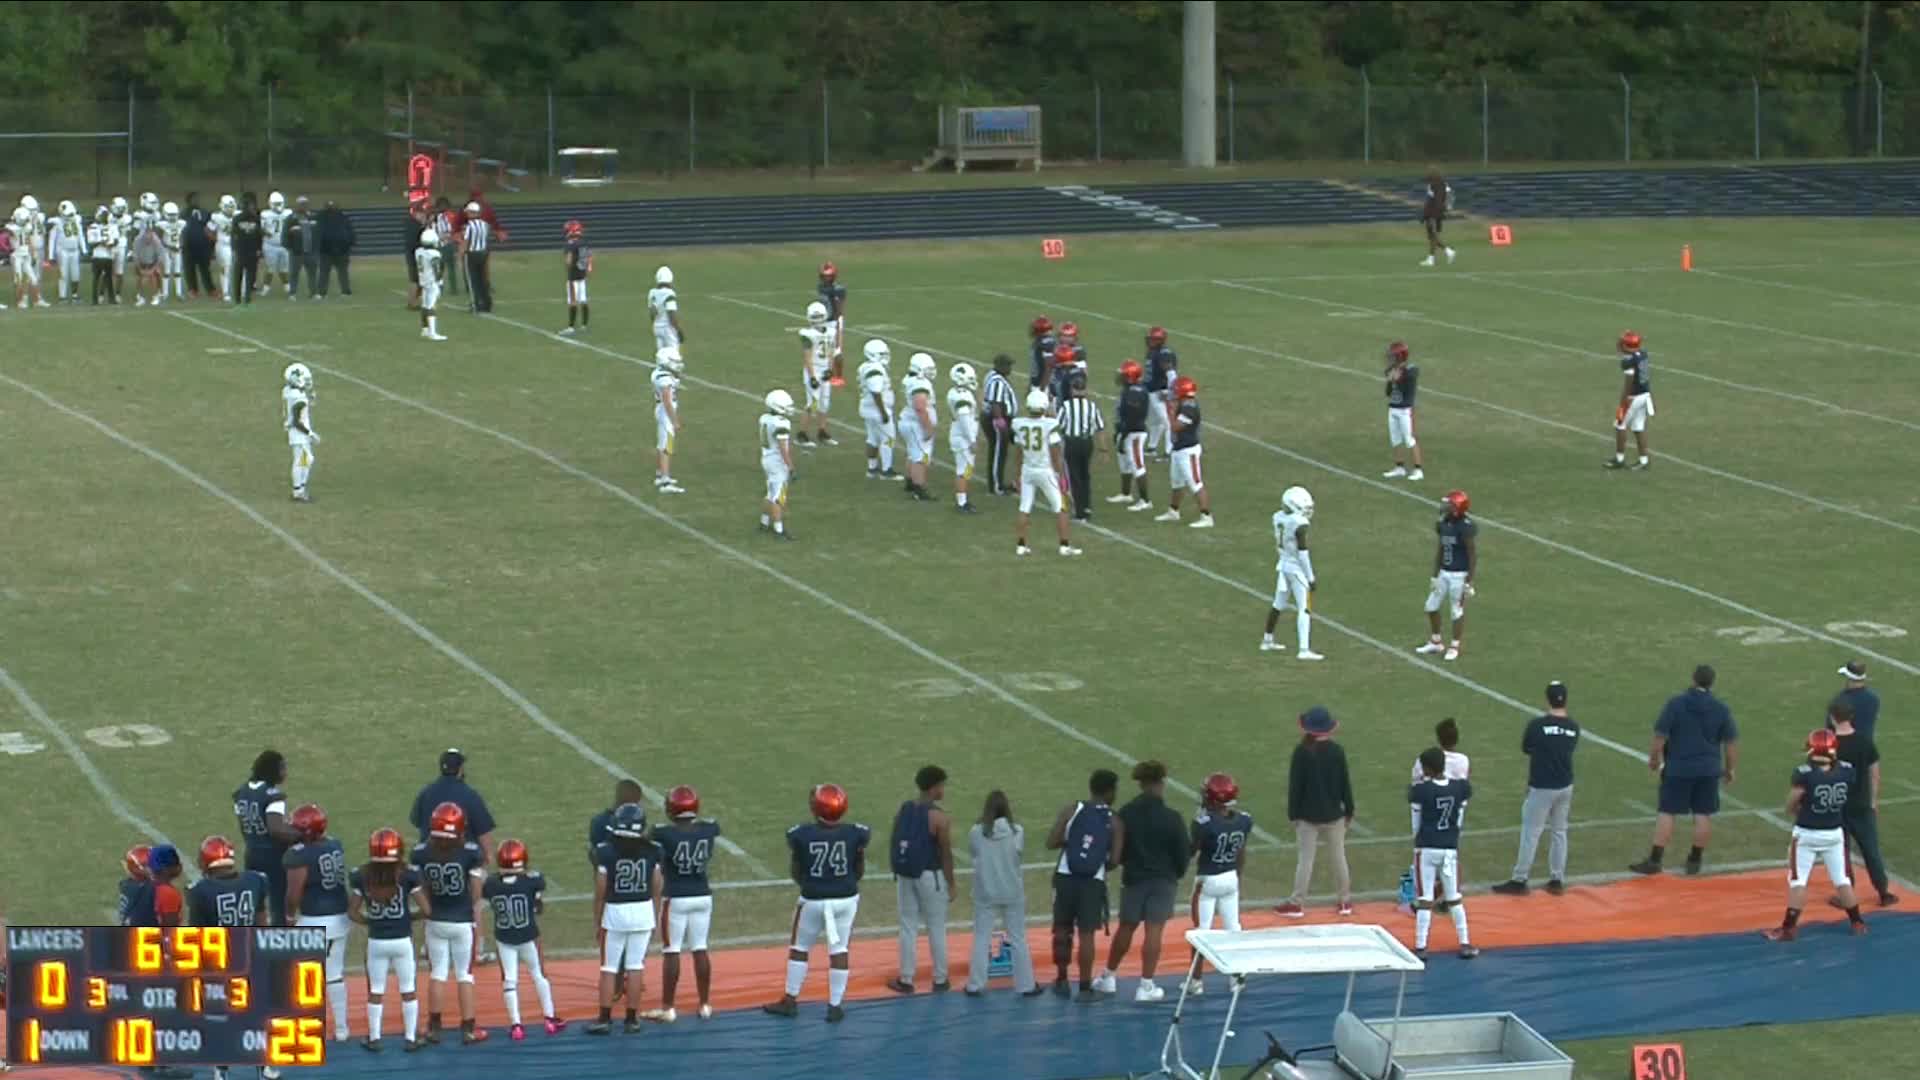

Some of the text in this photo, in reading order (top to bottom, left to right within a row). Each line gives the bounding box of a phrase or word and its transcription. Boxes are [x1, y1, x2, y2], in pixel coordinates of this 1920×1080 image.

[1019, 426, 1042, 451] 33
[1436, 796, 1455, 830] 7
[673, 839, 709, 875] 44
[809, 840, 848, 876] 74
[1212, 831, 1245, 863] 13
[615, 858, 647, 892] 21
[216, 890, 256, 926] 54
[1640, 1048, 1680, 1080] 30
